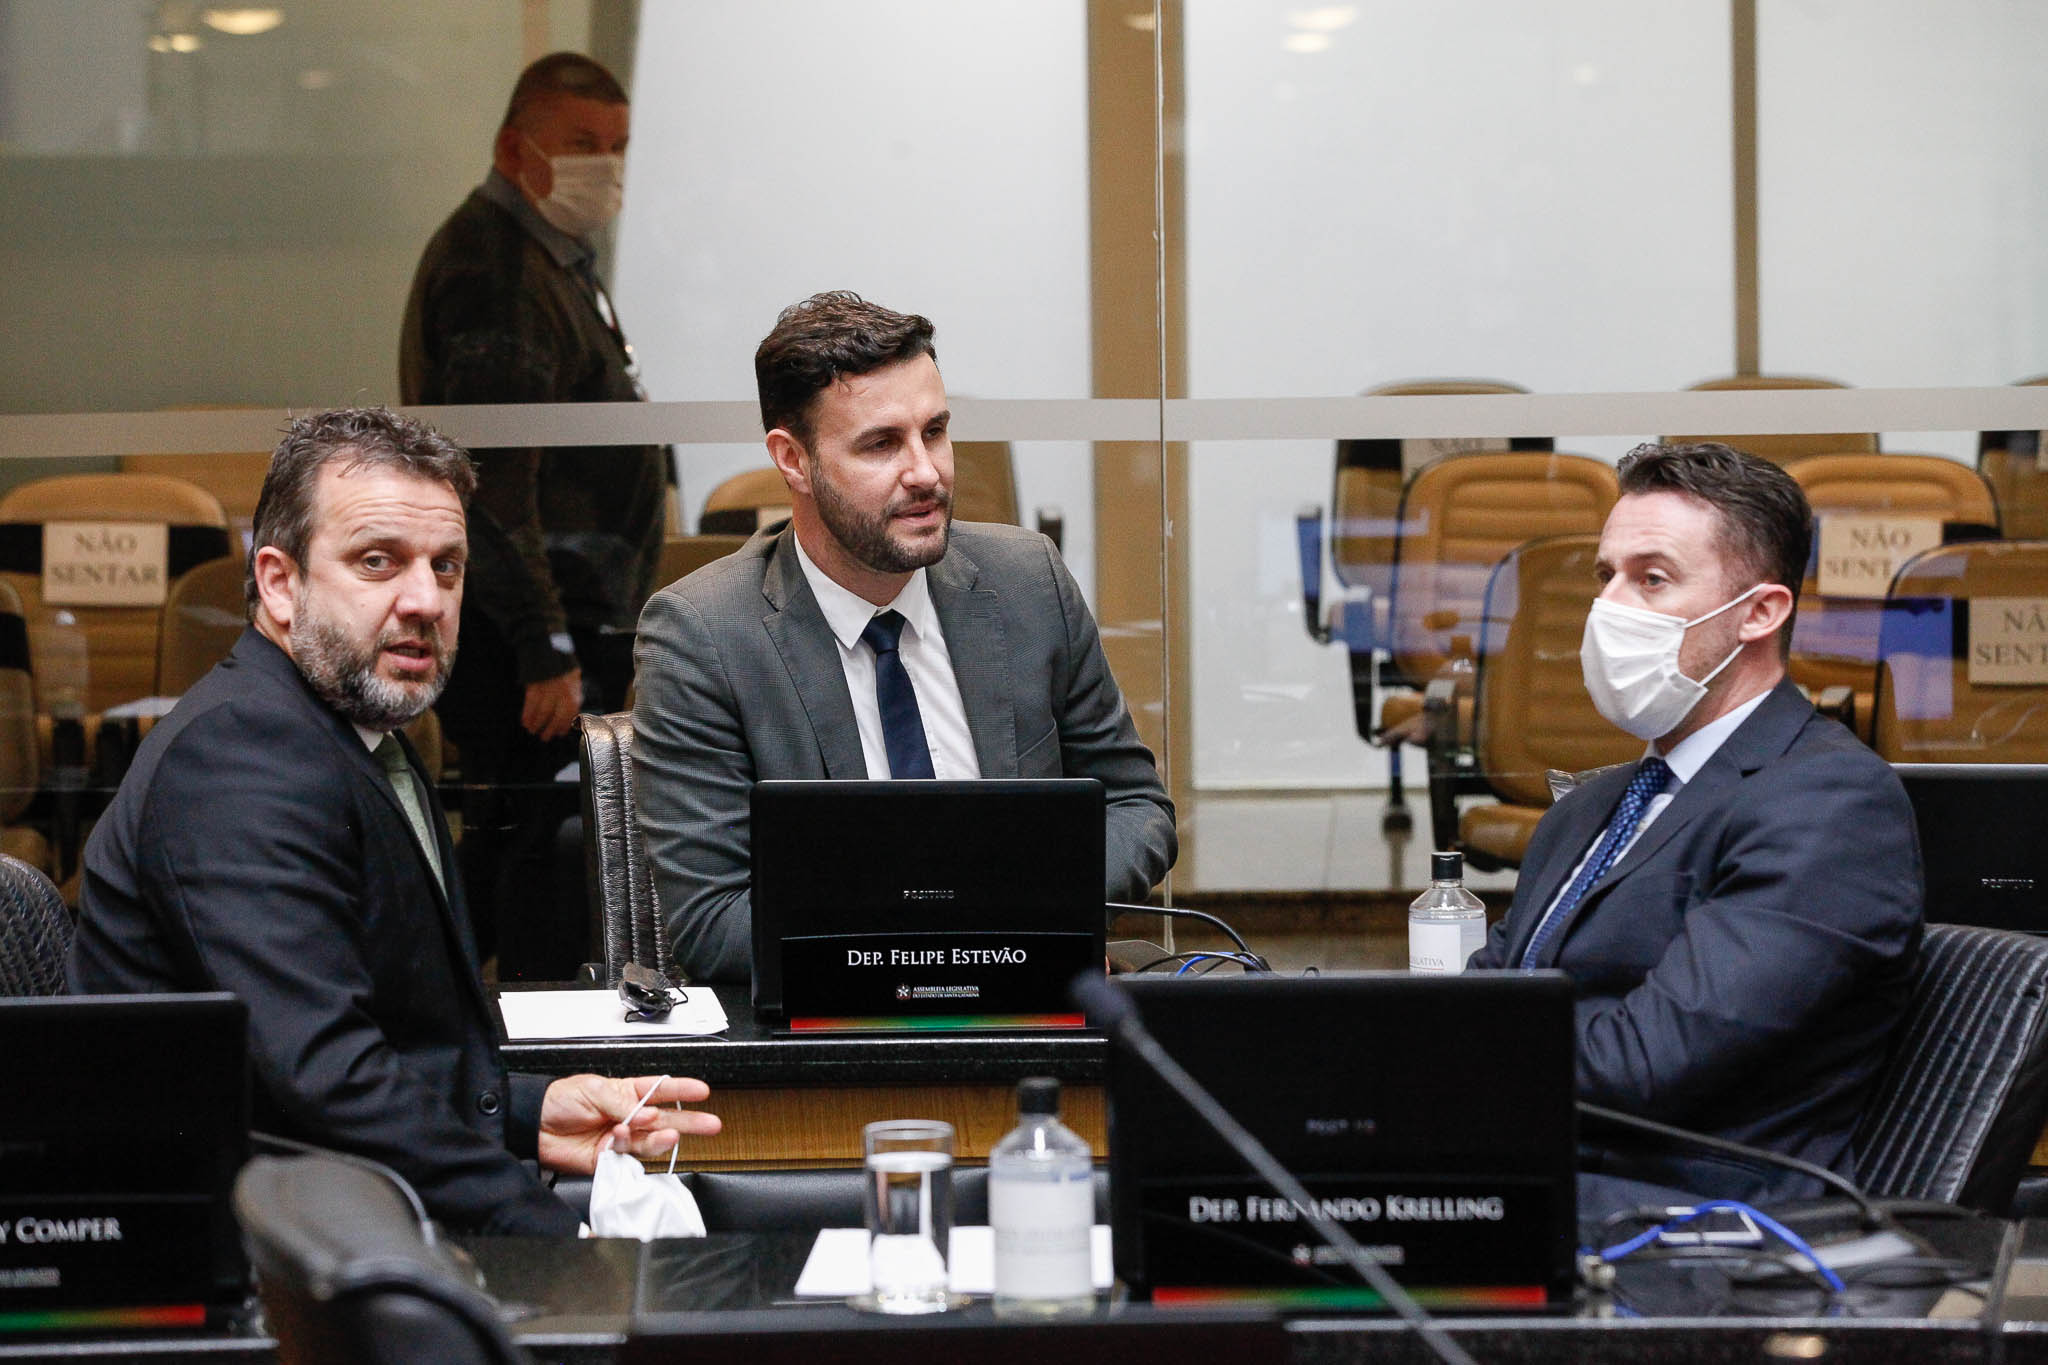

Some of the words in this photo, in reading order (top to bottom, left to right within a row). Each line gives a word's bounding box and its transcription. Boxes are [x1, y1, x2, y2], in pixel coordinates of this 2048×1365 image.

[74, 528, 138, 553] NÃO
[1850, 523, 1912, 547] NÃO
[50, 563, 160, 585] SENTAR
[1824, 557, 1892, 578] SENT
[2002, 603, 2048, 631] NÃ
[1975, 643, 2048, 665] SENT
[847, 949, 884, 966] DEP.
[891, 949, 945, 966] FELIPE
[951, 947, 1027, 965] ESTEVÃO
[1189, 1195, 1241, 1223] DEP.
[1386, 1194, 1505, 1222] KRELLING
[15, 1216, 123, 1244] COMPER
